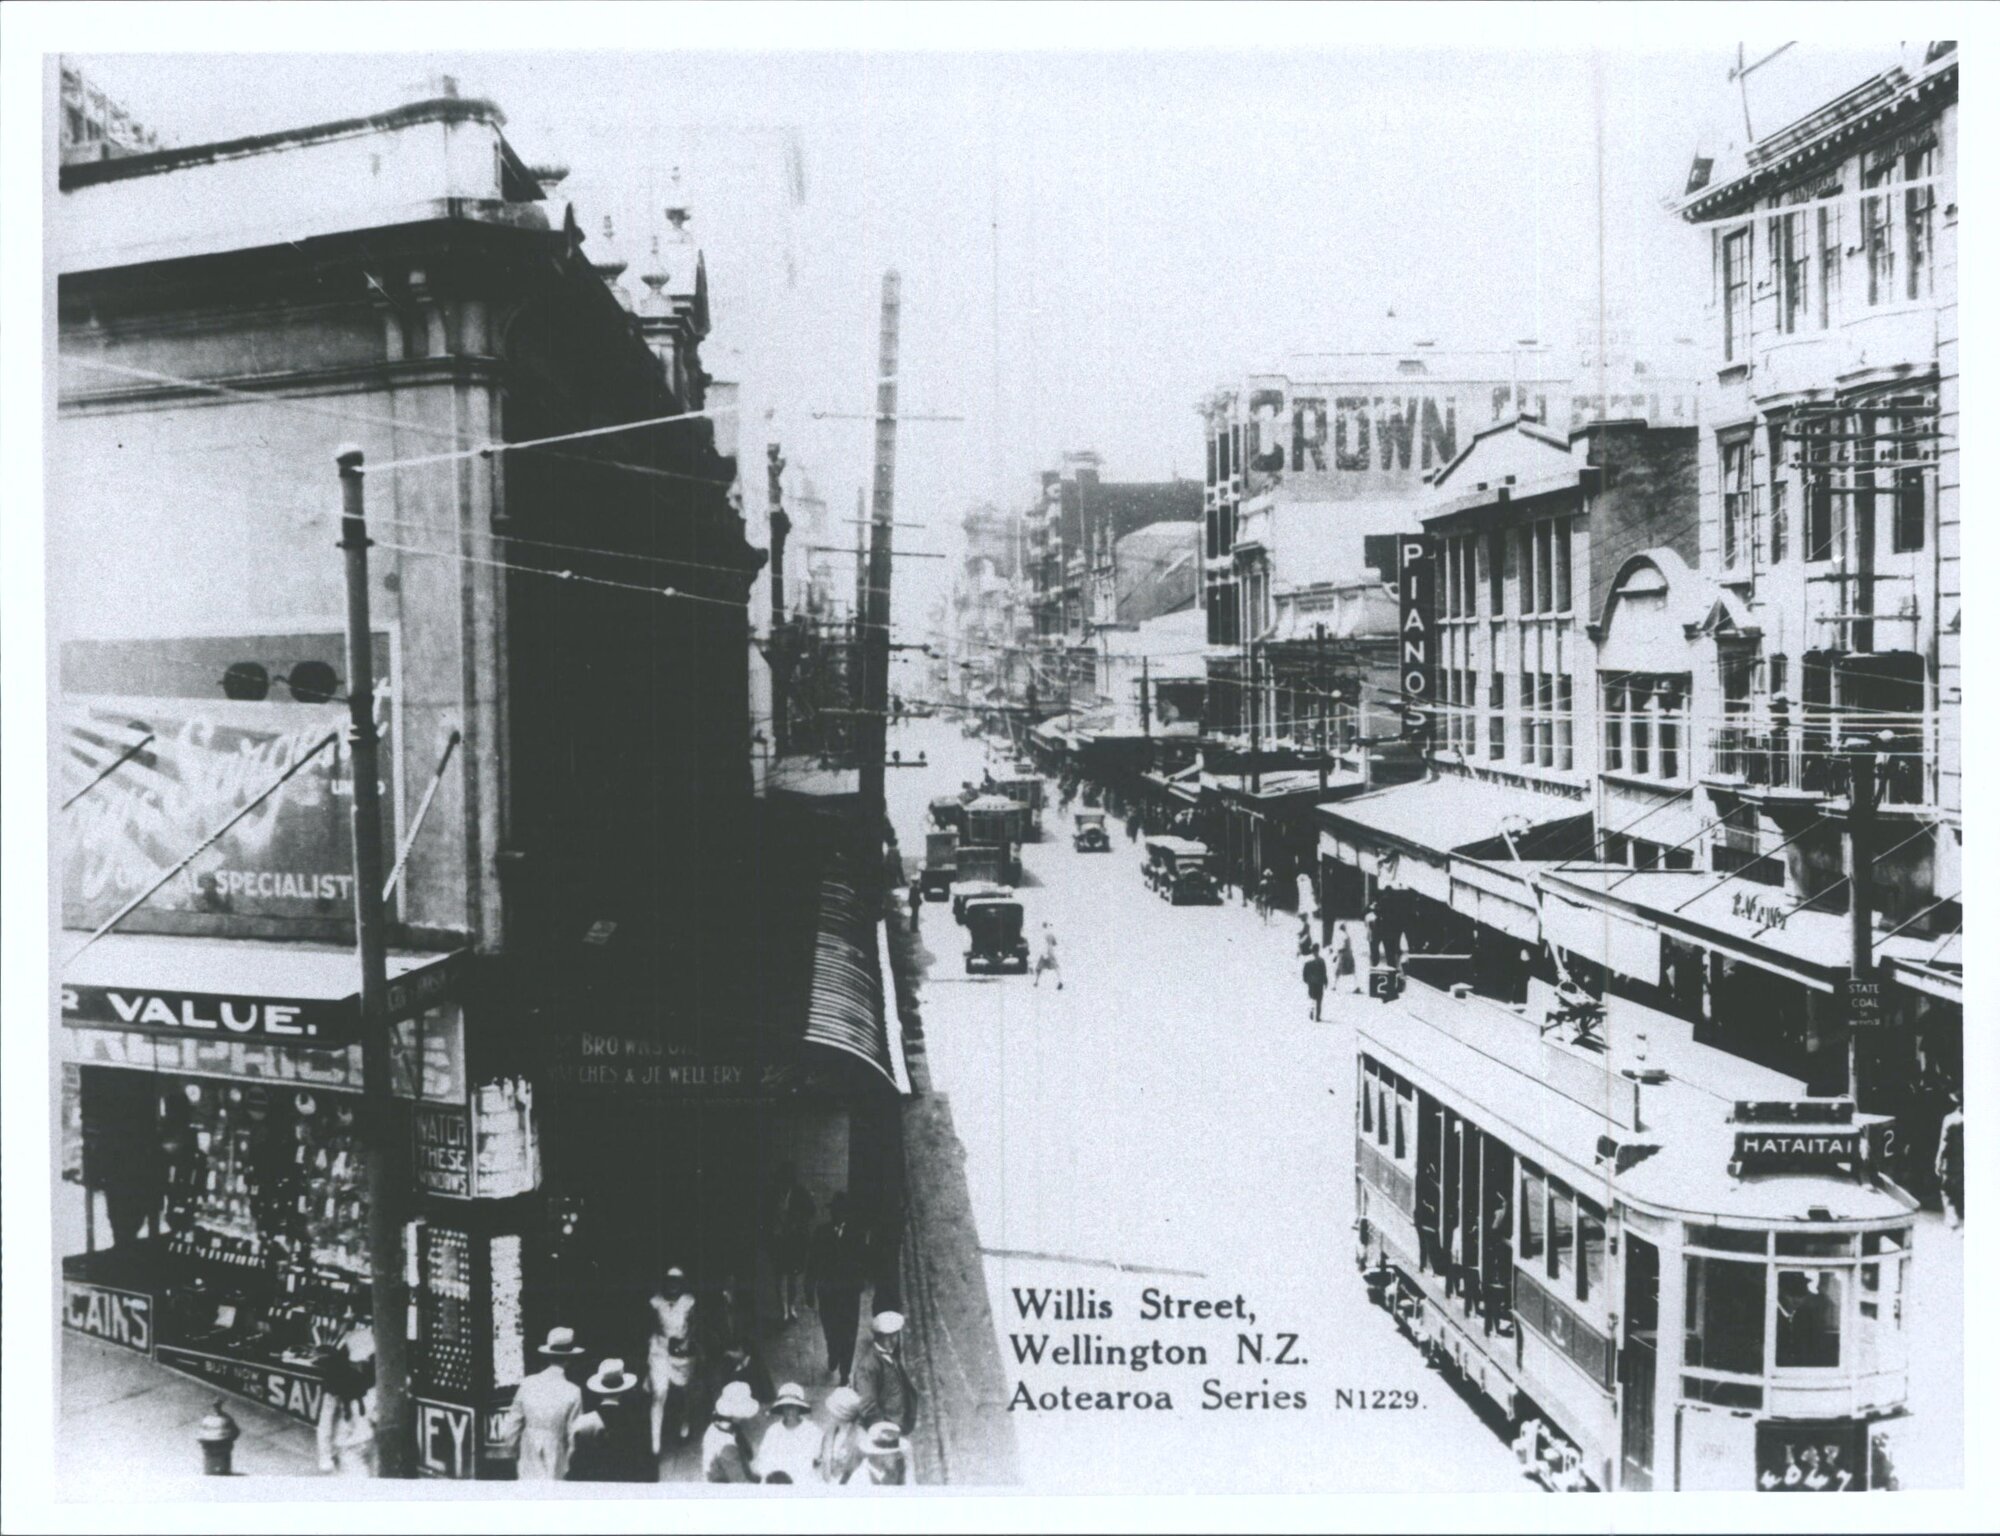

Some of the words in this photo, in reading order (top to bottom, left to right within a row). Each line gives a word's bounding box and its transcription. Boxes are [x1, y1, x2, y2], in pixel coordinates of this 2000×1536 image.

[1249, 390, 1457, 472] CROWN
[1403, 543, 1427, 726] PIANOS
[215, 870, 354, 900] SPECIALIST
[1376, 974, 1388, 995] 2
[1848, 983, 1880, 994] STATE
[106, 992, 317, 1036] VALUE.
[1851, 997, 1879, 1008] COAL
[624, 1068, 636, 1084] &
[1742, 1138, 1853, 1155] HATAITAI
[1883, 1128, 1896, 1158] 2
[267, 1374, 322, 1420] SAV
[417, 1405, 469, 1478] EY
